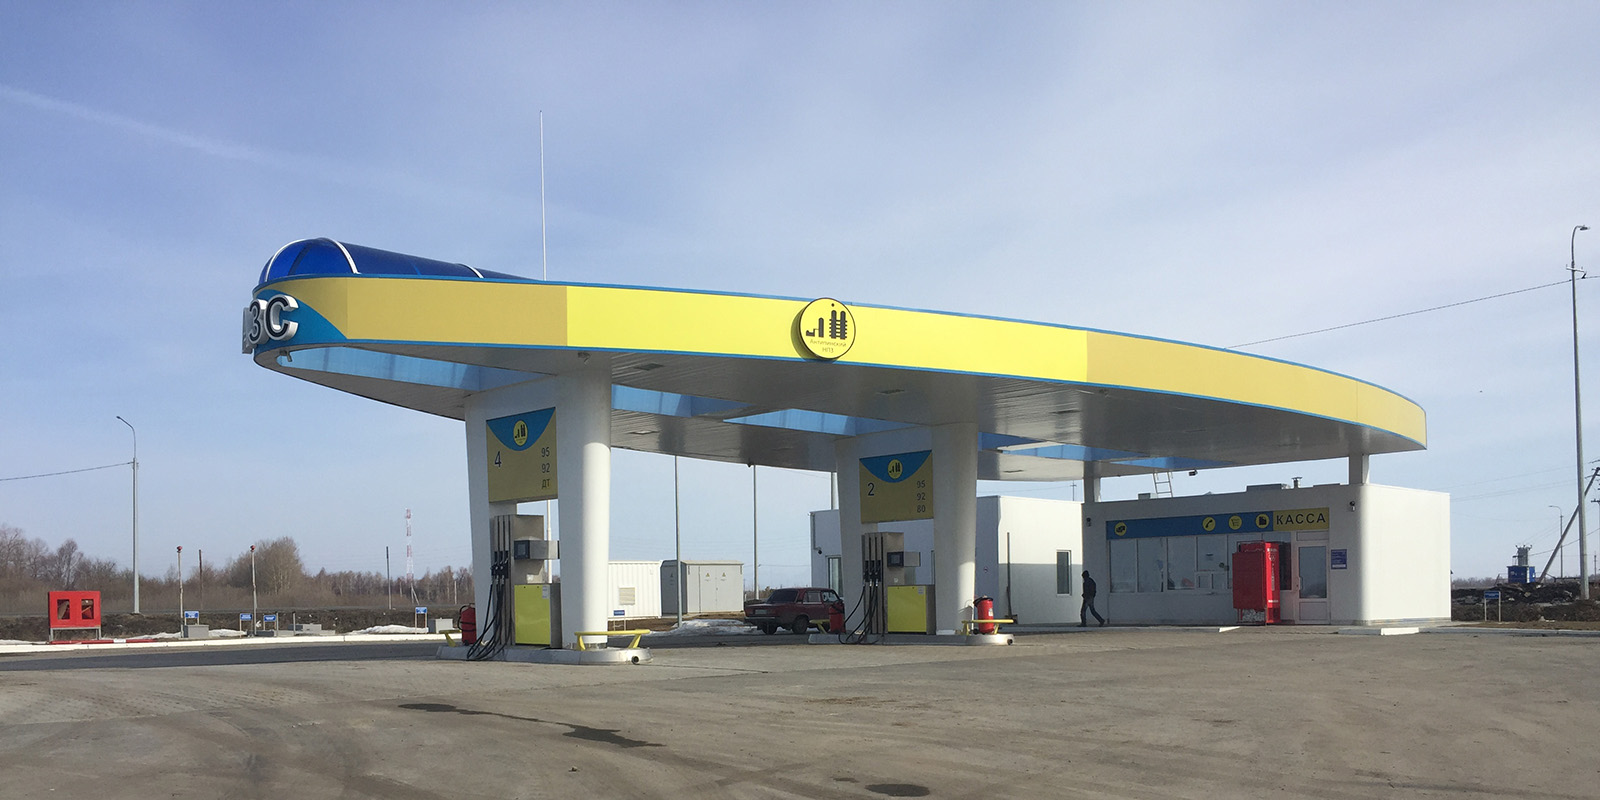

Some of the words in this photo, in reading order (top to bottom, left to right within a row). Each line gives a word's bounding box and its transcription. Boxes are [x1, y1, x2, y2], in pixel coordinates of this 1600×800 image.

[541, 446, 550, 457] 95
[494, 451, 502, 468] 4
[541, 463, 550, 473] 92
[541, 479, 551, 489] ДТ
[867, 482, 875, 496] 2
[917, 480, 926, 489] 95
[917, 492, 926, 501] 92
[917, 505, 926, 513] 80
[1276, 512, 1326, 525] КАССА
